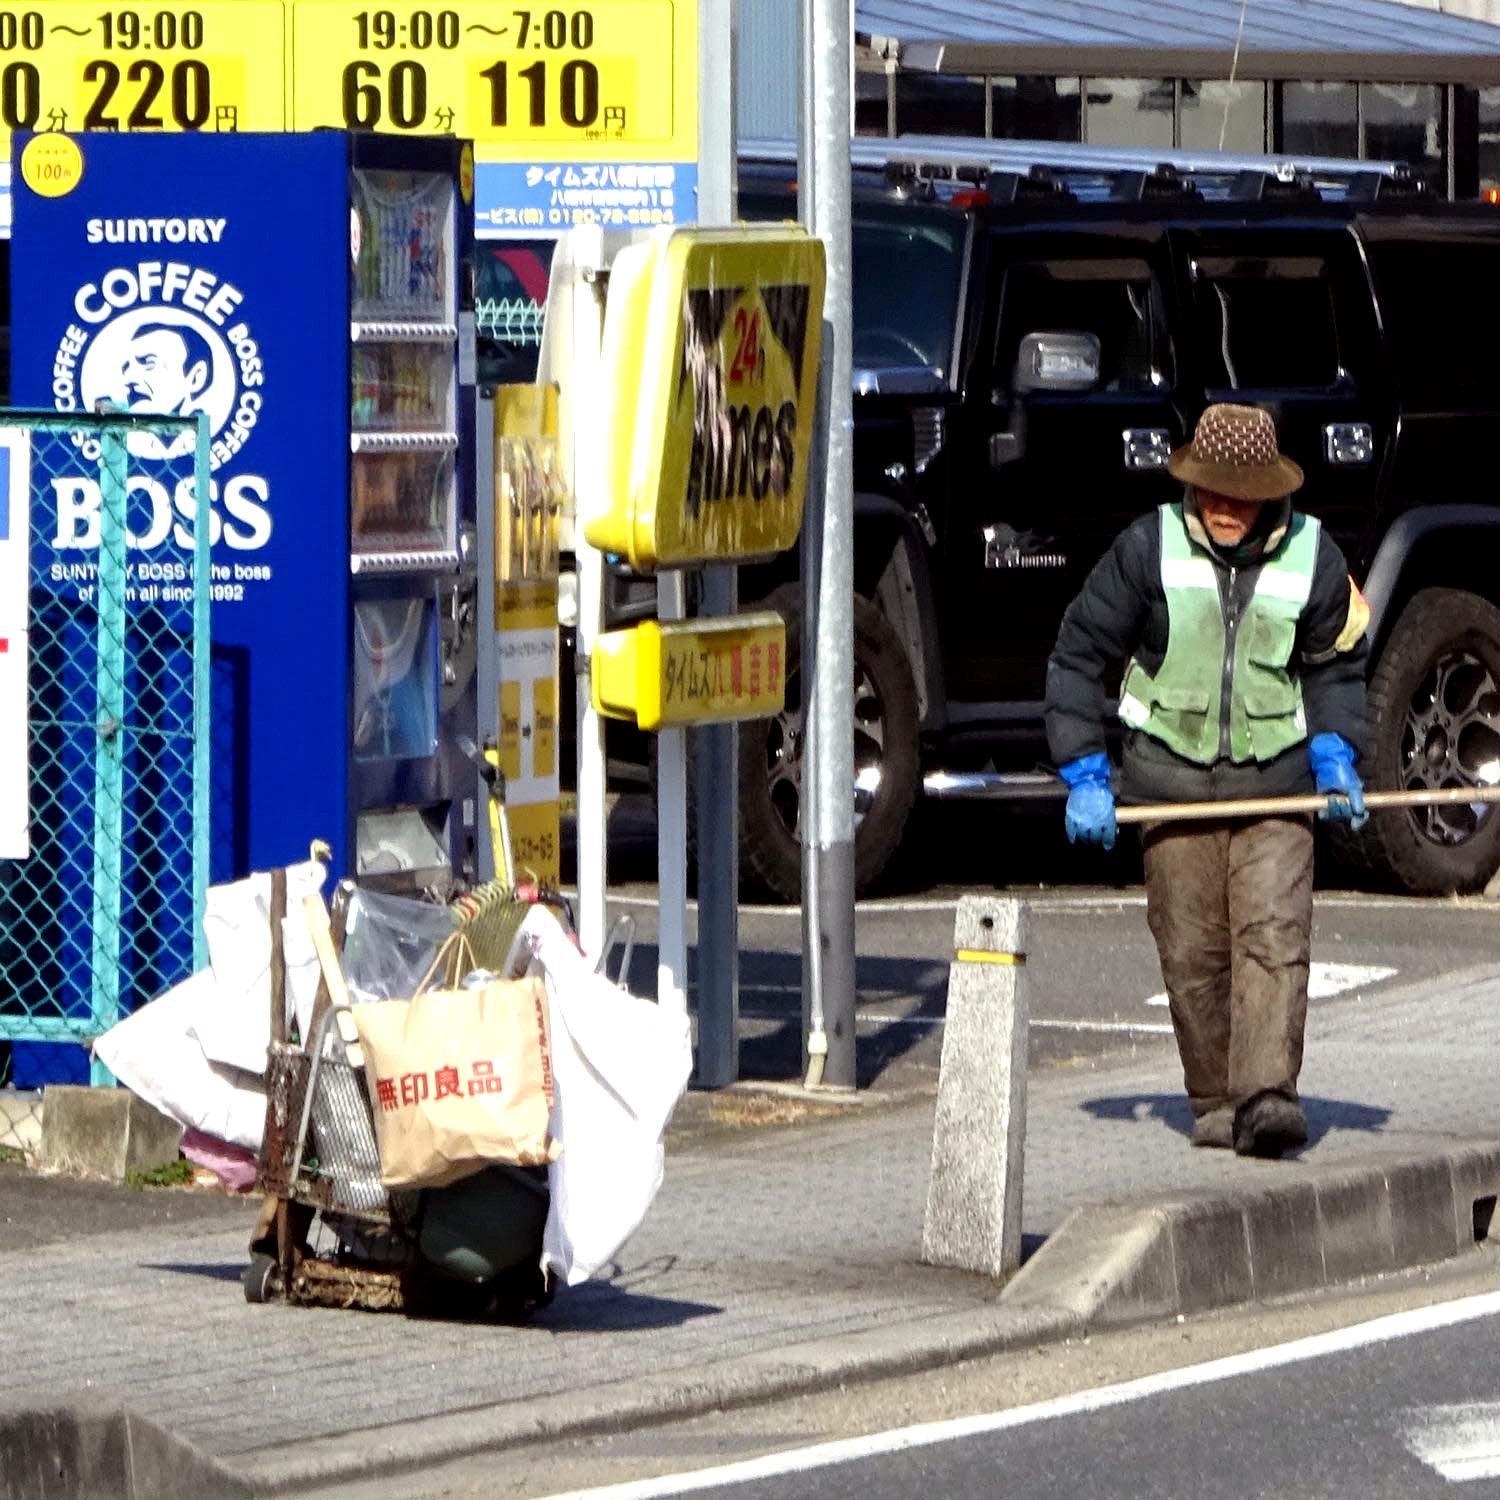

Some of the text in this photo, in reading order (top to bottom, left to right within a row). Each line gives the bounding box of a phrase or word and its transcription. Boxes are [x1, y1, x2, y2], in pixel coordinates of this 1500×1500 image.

[525, 166, 675, 187] タイムズ八
[74, 262, 243, 326] COFFEE
[227, 322, 264, 387] BOSS
[50, 475, 272, 550] BOSS
[51, 563, 134, 581] SUNTY
[139, 563, 186, 580] BOSS
[211, 563, 231, 580] he
[235, 563, 271, 580] boss
[78, 584, 94, 602] of
[140, 584, 157, 602] all
[162, 585, 194, 602] sinc
[376, 1060, 503, 1113] 無印良品
